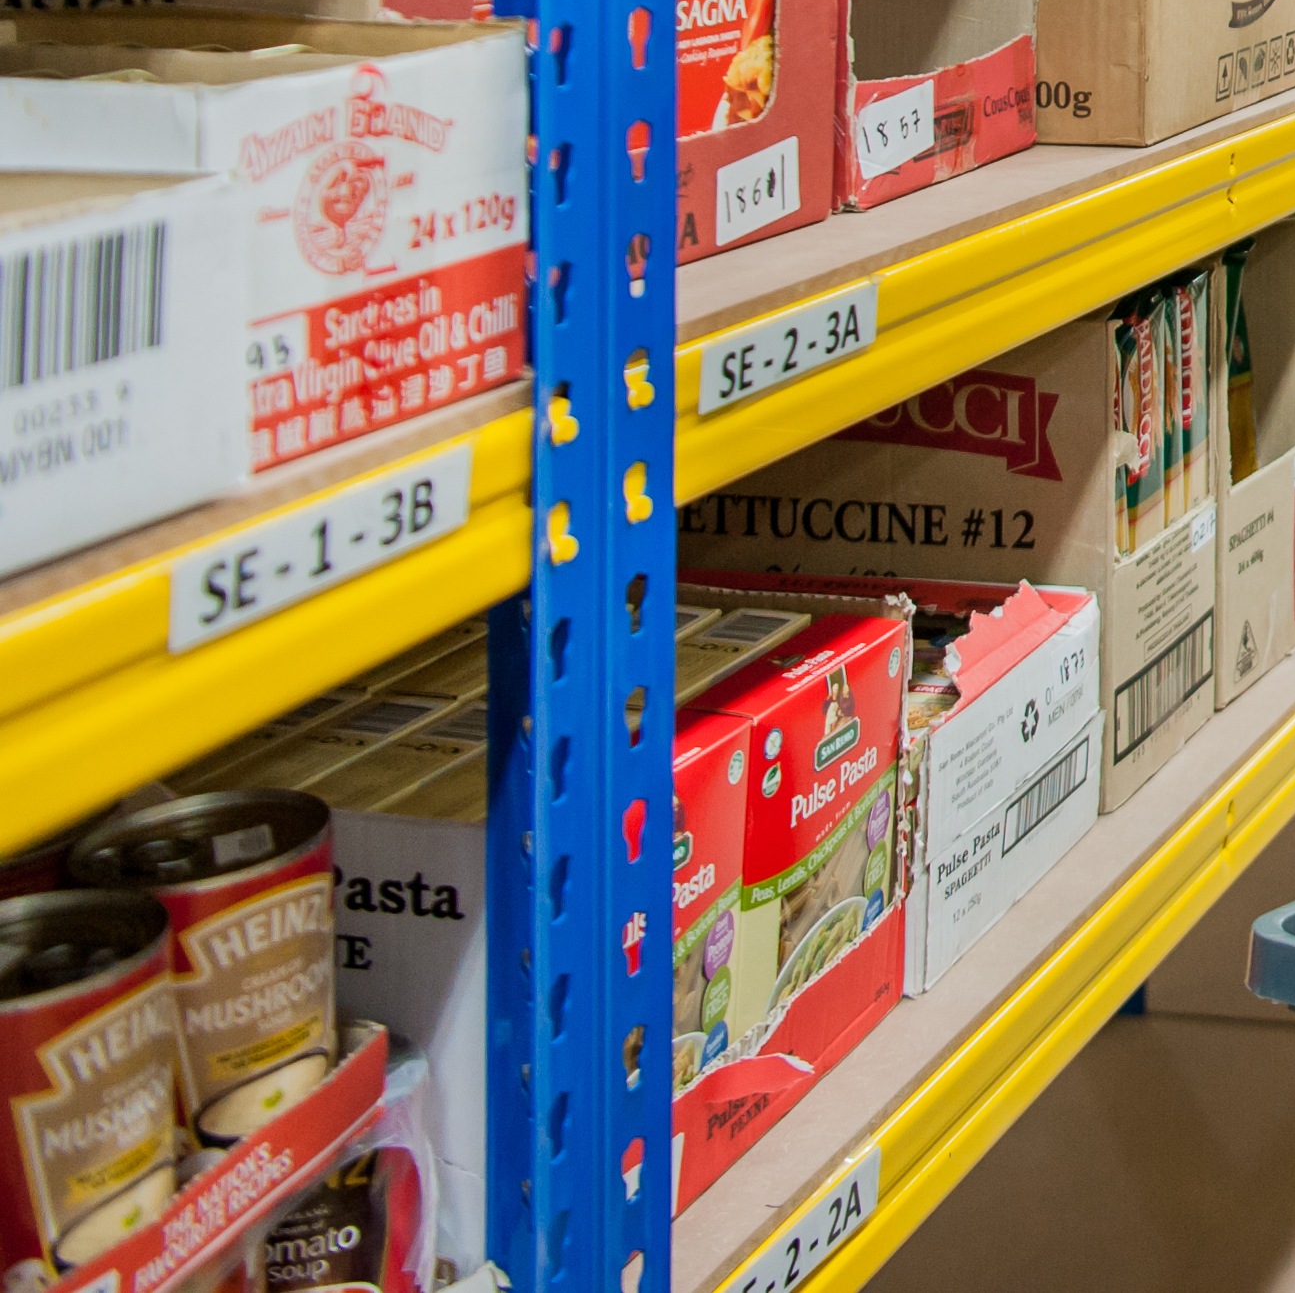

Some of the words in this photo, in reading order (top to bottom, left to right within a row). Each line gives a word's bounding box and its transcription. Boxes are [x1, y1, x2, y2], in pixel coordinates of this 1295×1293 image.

[862, 109, 921, 154] 1857
[409, 211, 435, 249] 24
[442, 213, 455, 239] x
[463, 192, 515, 232] 120g
[418, 278, 442, 316] in
[291, 348, 362, 405] Virgin
[418, 315, 450, 360] Oil
[450, 312, 467, 349] &
[468, 292, 518, 342] Chilli
[719, 344, 755, 399] SE
[824, 305, 860, 355] 3A
[677, 493, 949, 547] ETTUCCINE
[961, 508, 1036, 549] #12
[199, 547, 260, 626] SE
[378, 479, 434, 547] 3B
[790, 778, 837, 829] Pulse
[839, 746, 878, 795] Pasta
[751, 879, 776, 904] Peas,
[808, 828, 848, 872] Chickpeas
[936, 848, 969, 886] Pulse
[972, 821, 1001, 857] Pasta
[944, 850, 992, 901] SPAGHETTI
[333, 865, 465, 921] asta
[673, 861, 716, 910] Pasta
[208, 893, 330, 971] HEINZ
[826, 1181, 862, 1246] 2A
[268, 1258, 330, 1283] soup
